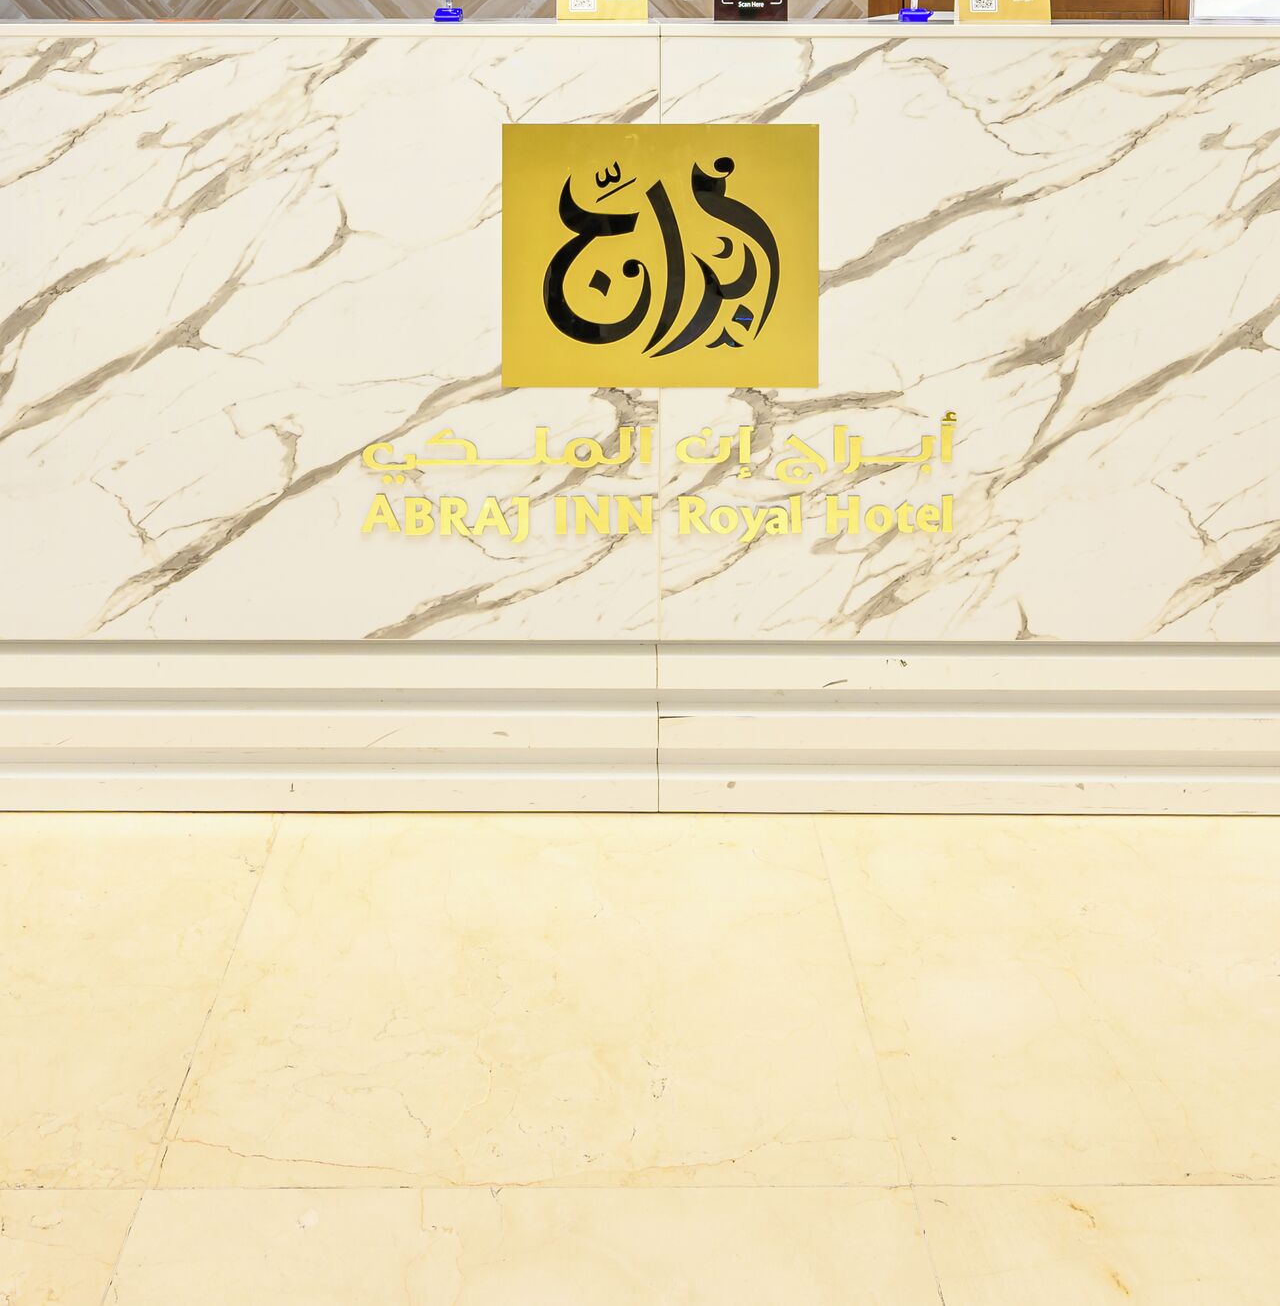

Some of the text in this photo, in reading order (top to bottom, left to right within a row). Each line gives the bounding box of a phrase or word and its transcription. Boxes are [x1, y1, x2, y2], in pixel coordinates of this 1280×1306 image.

[361, 411, 958, 487] أبراج إن الملكي
[360, 493, 954, 544] ABRAJ INN Royal Hotel
